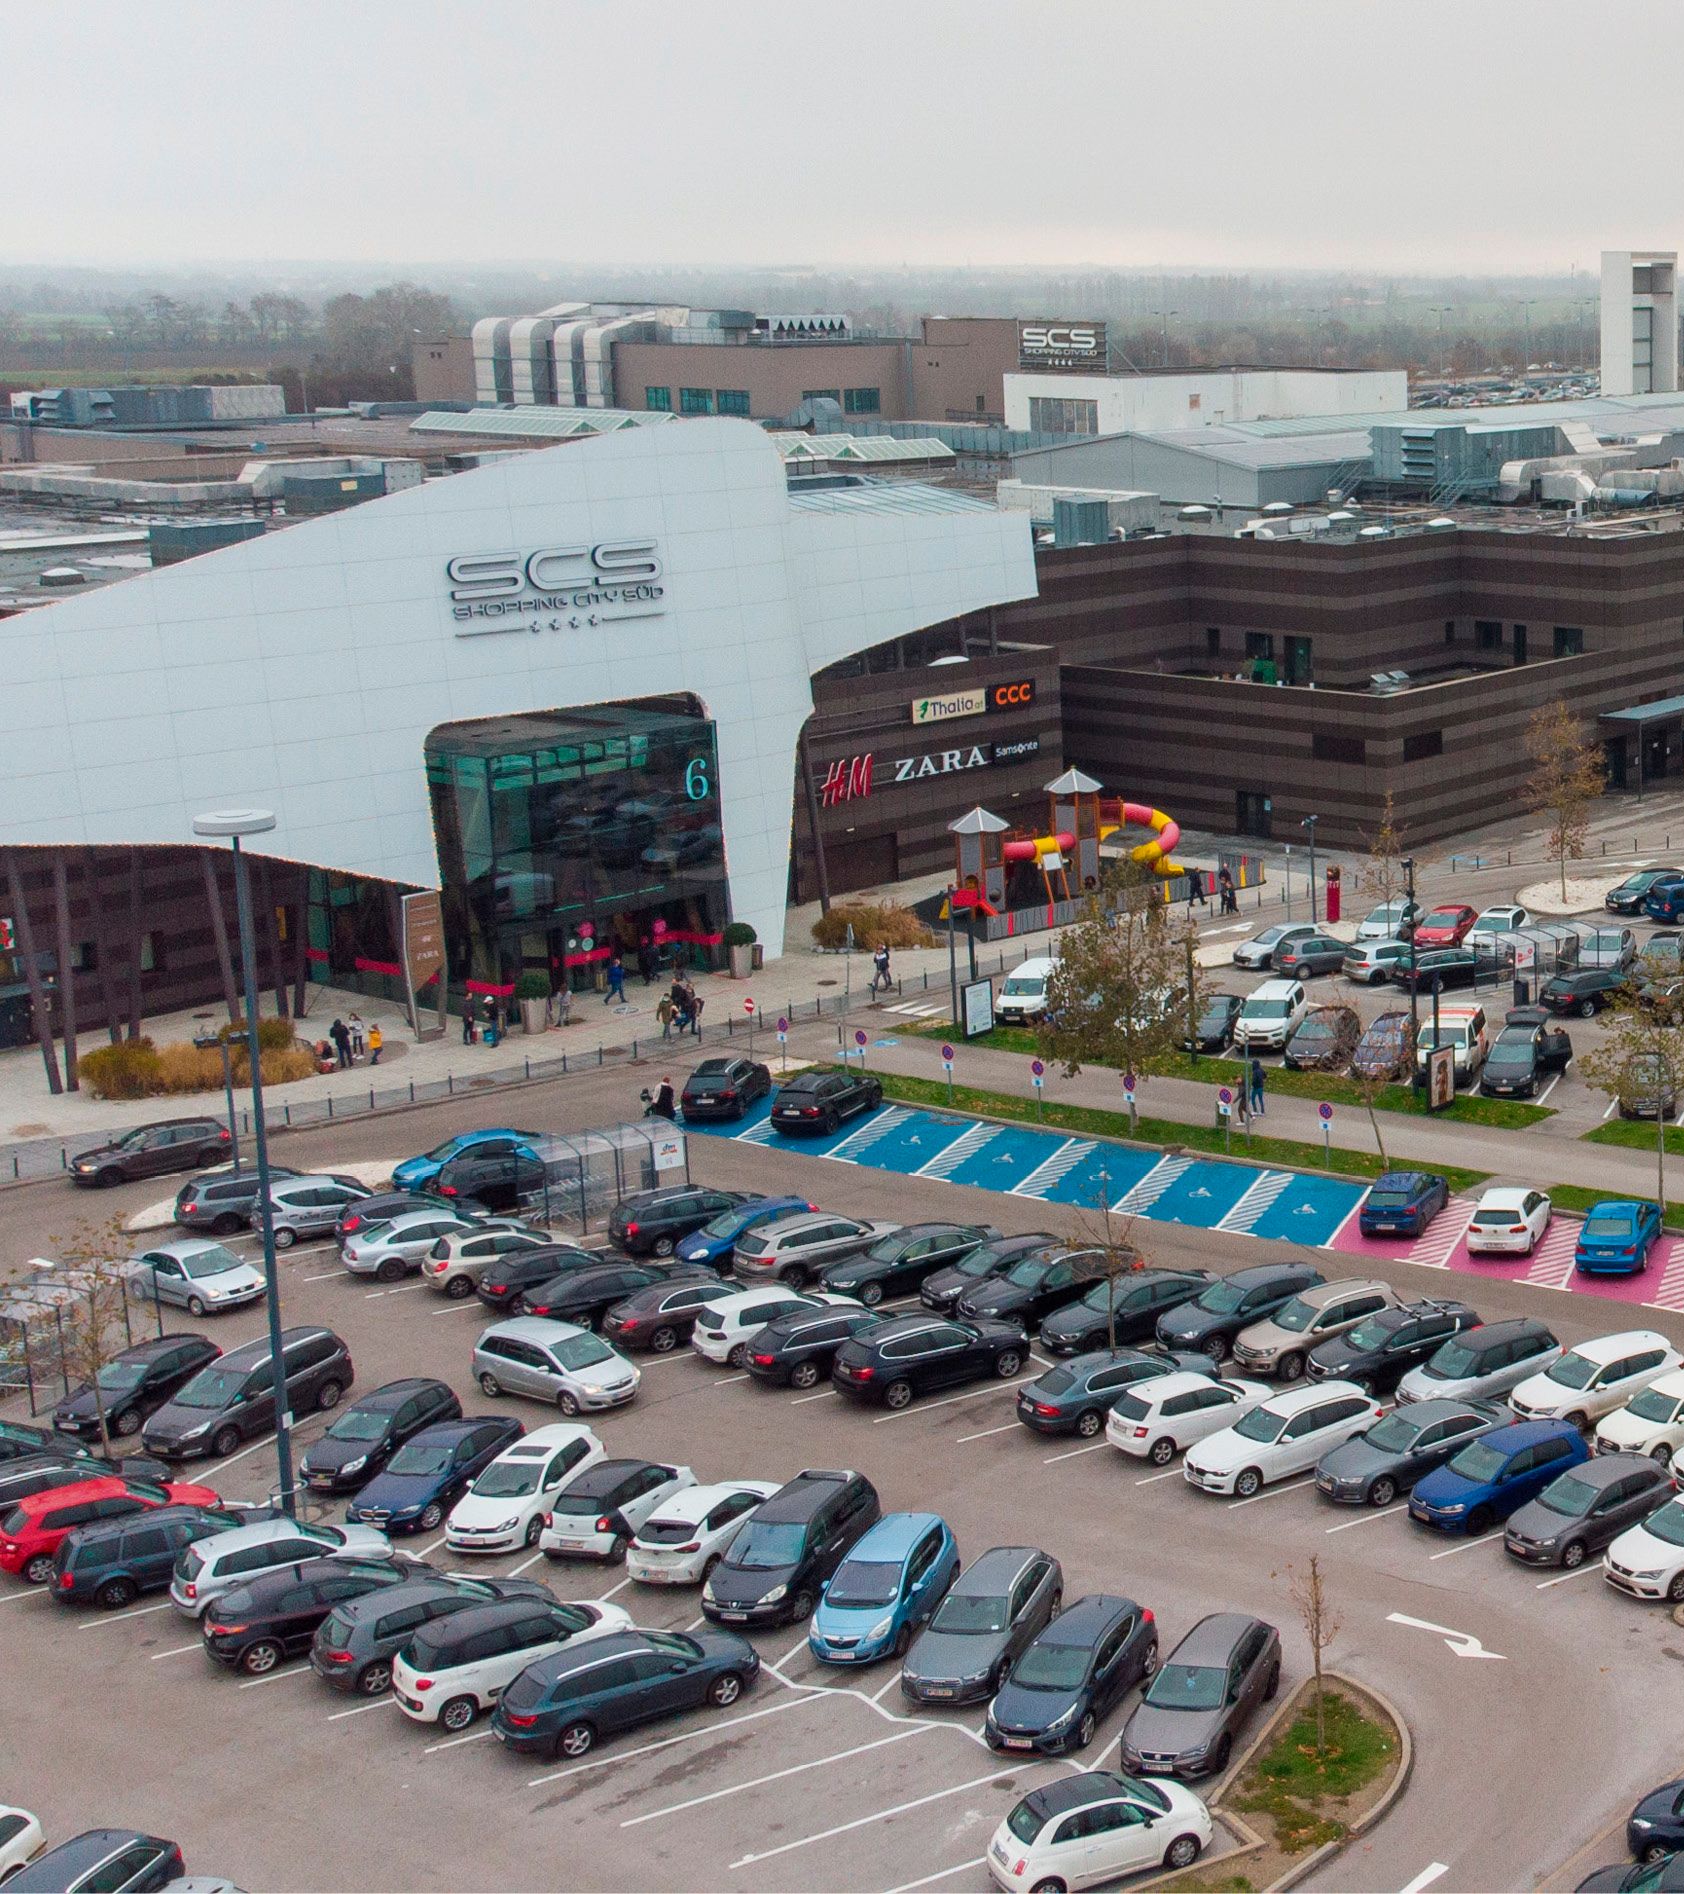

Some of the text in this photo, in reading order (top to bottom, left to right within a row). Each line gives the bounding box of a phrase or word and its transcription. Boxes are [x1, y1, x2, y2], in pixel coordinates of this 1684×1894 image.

[1022, 328, 1096, 348] SCS
[447, 539, 663, 600] SCS
[453, 584, 664, 621] SHOPPING CITY SÜD
[930, 697, 974, 717] Thalia
[995, 683, 1031, 705] CCC
[895, 746, 988, 781] ZARA
[996, 741, 1038, 757] Samsonite
[686, 758, 709, 800] 6
[820, 753, 873, 807] H&M
